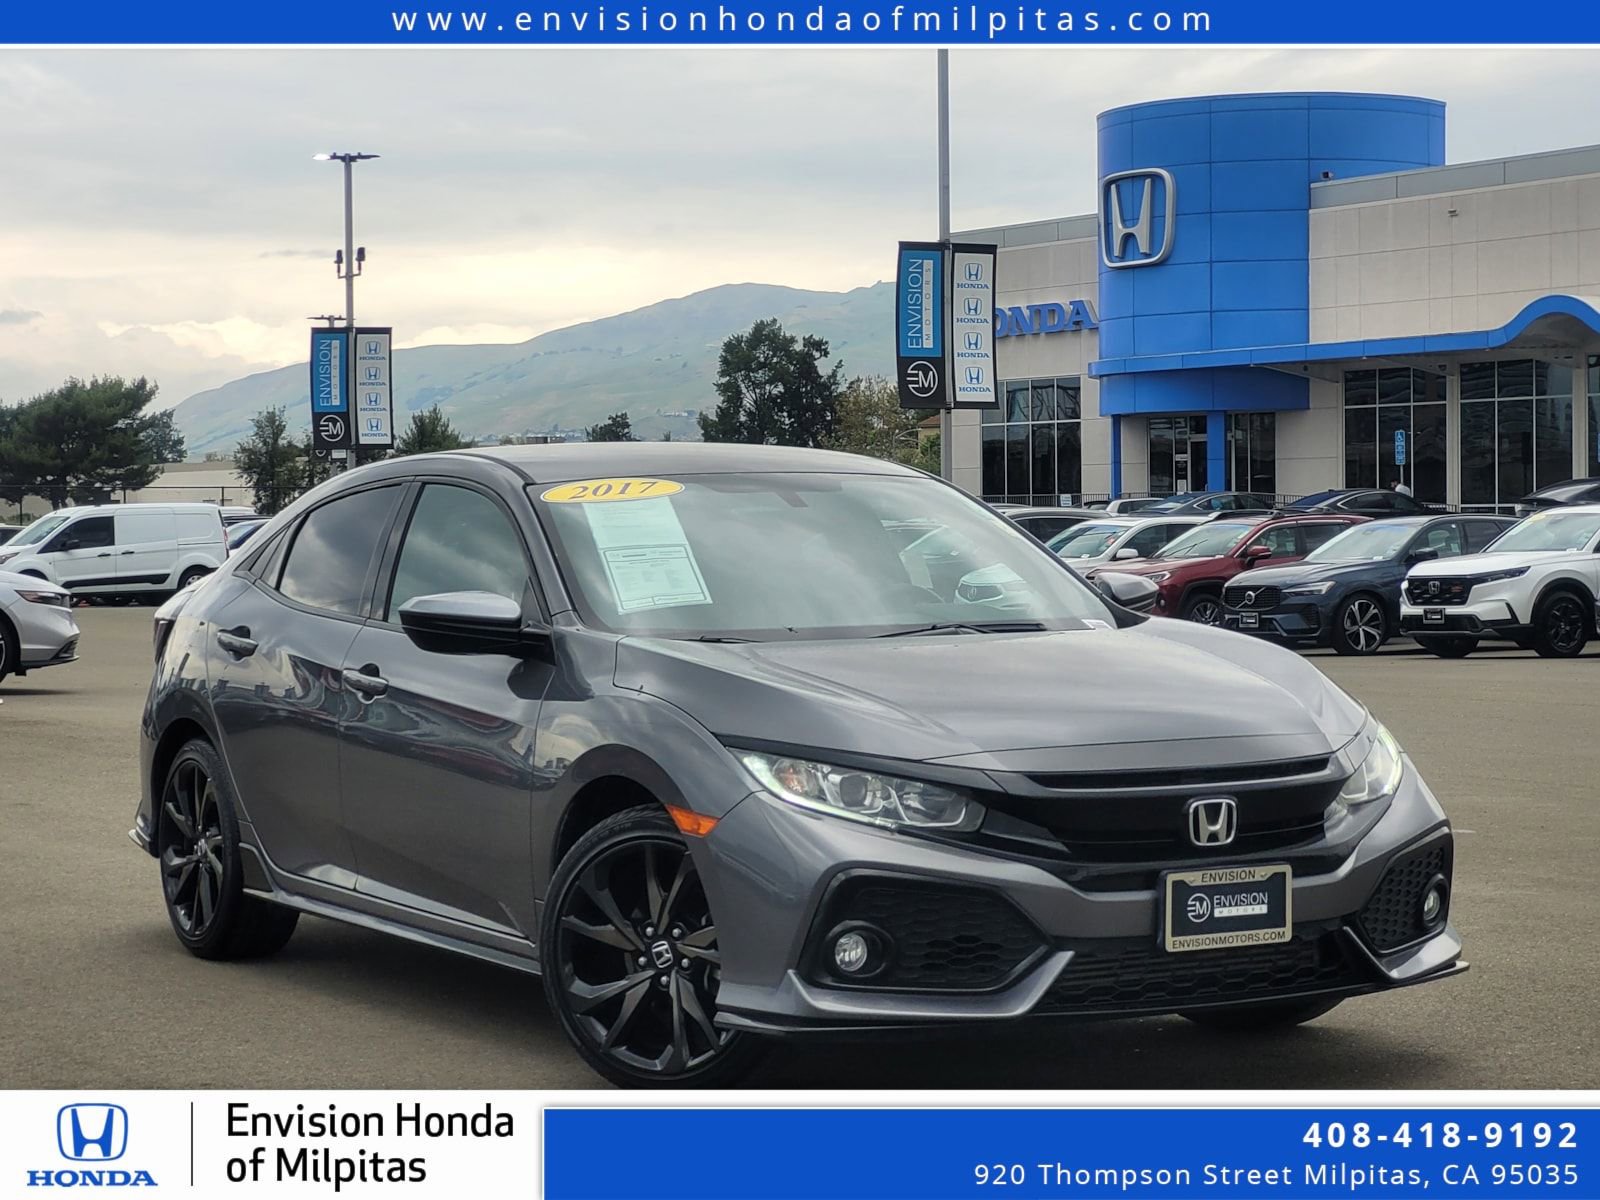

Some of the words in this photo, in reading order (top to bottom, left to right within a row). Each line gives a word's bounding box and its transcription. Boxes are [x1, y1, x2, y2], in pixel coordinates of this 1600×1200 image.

[908, 259, 922, 348] ENVISION
[995, 299, 1098, 337] ONDA
[320, 340, 330, 406] ENVISION
[568, 481, 657, 499] 2017
[1201, 869, 1256, 883] ENVISION
[1213, 892, 1268, 908] ENVISION
[1172, 931, 1286, 949] ENVISIONMOTORS.COM
